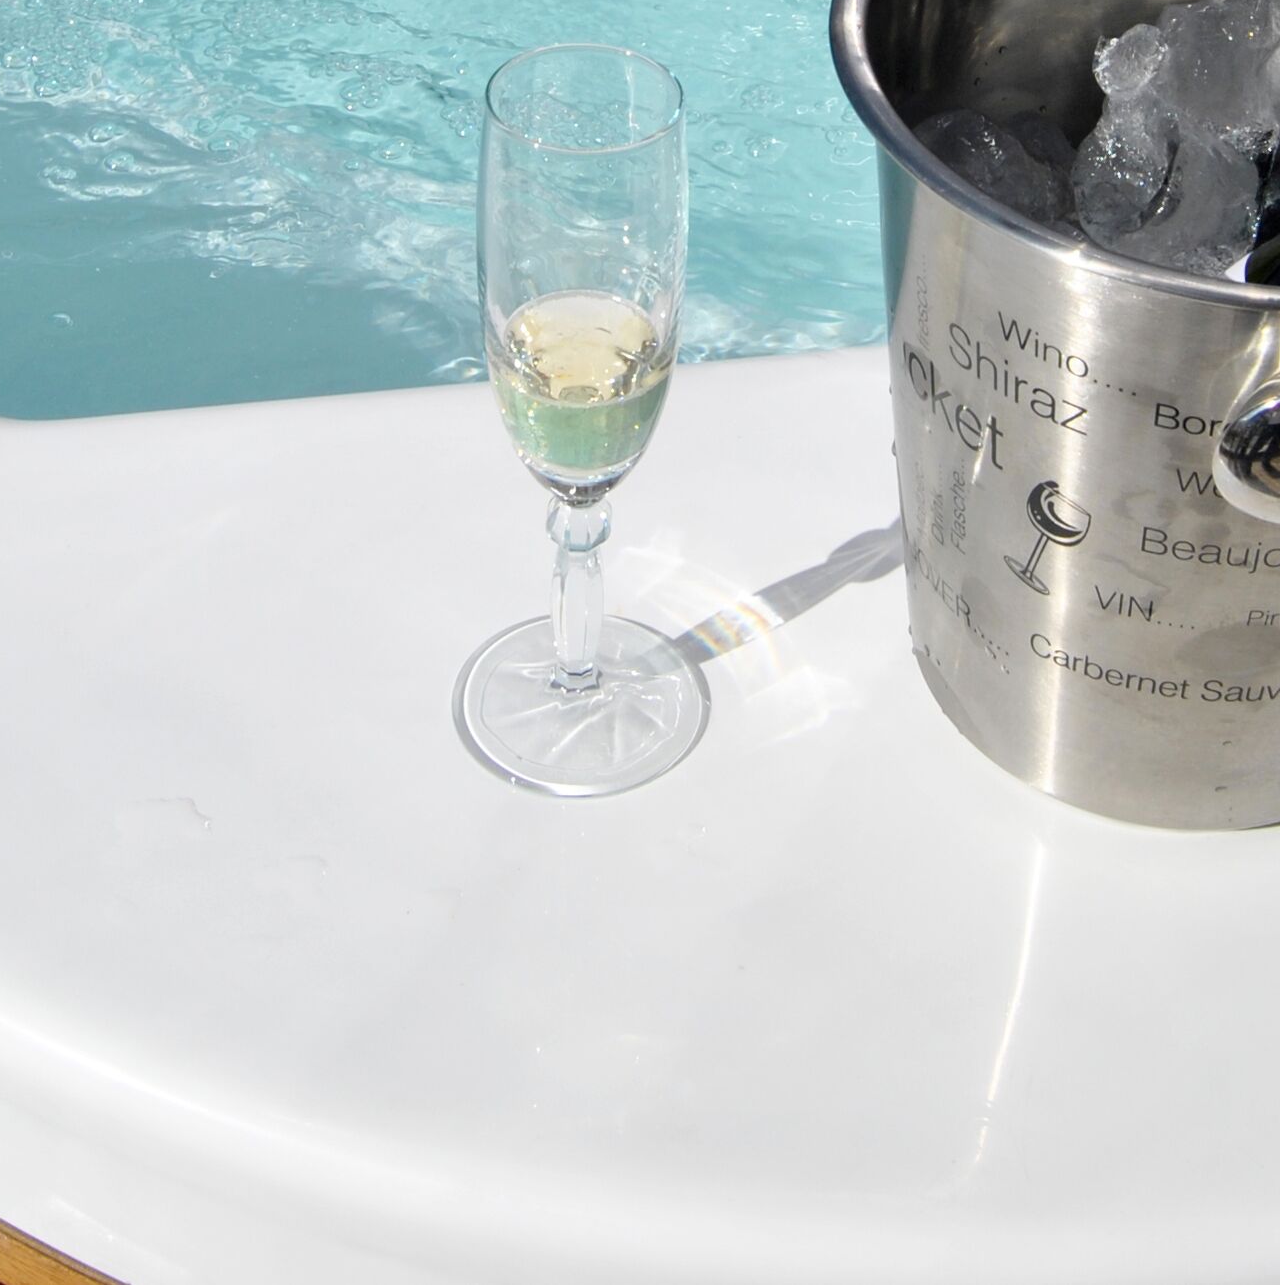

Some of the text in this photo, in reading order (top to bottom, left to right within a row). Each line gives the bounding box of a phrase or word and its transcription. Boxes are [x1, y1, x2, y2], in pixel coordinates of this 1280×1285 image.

[948, 322, 1089, 437] Shiraz
[1153, 402, 1233, 437] Bor
[1030, 633, 1189, 701] Carbernet
